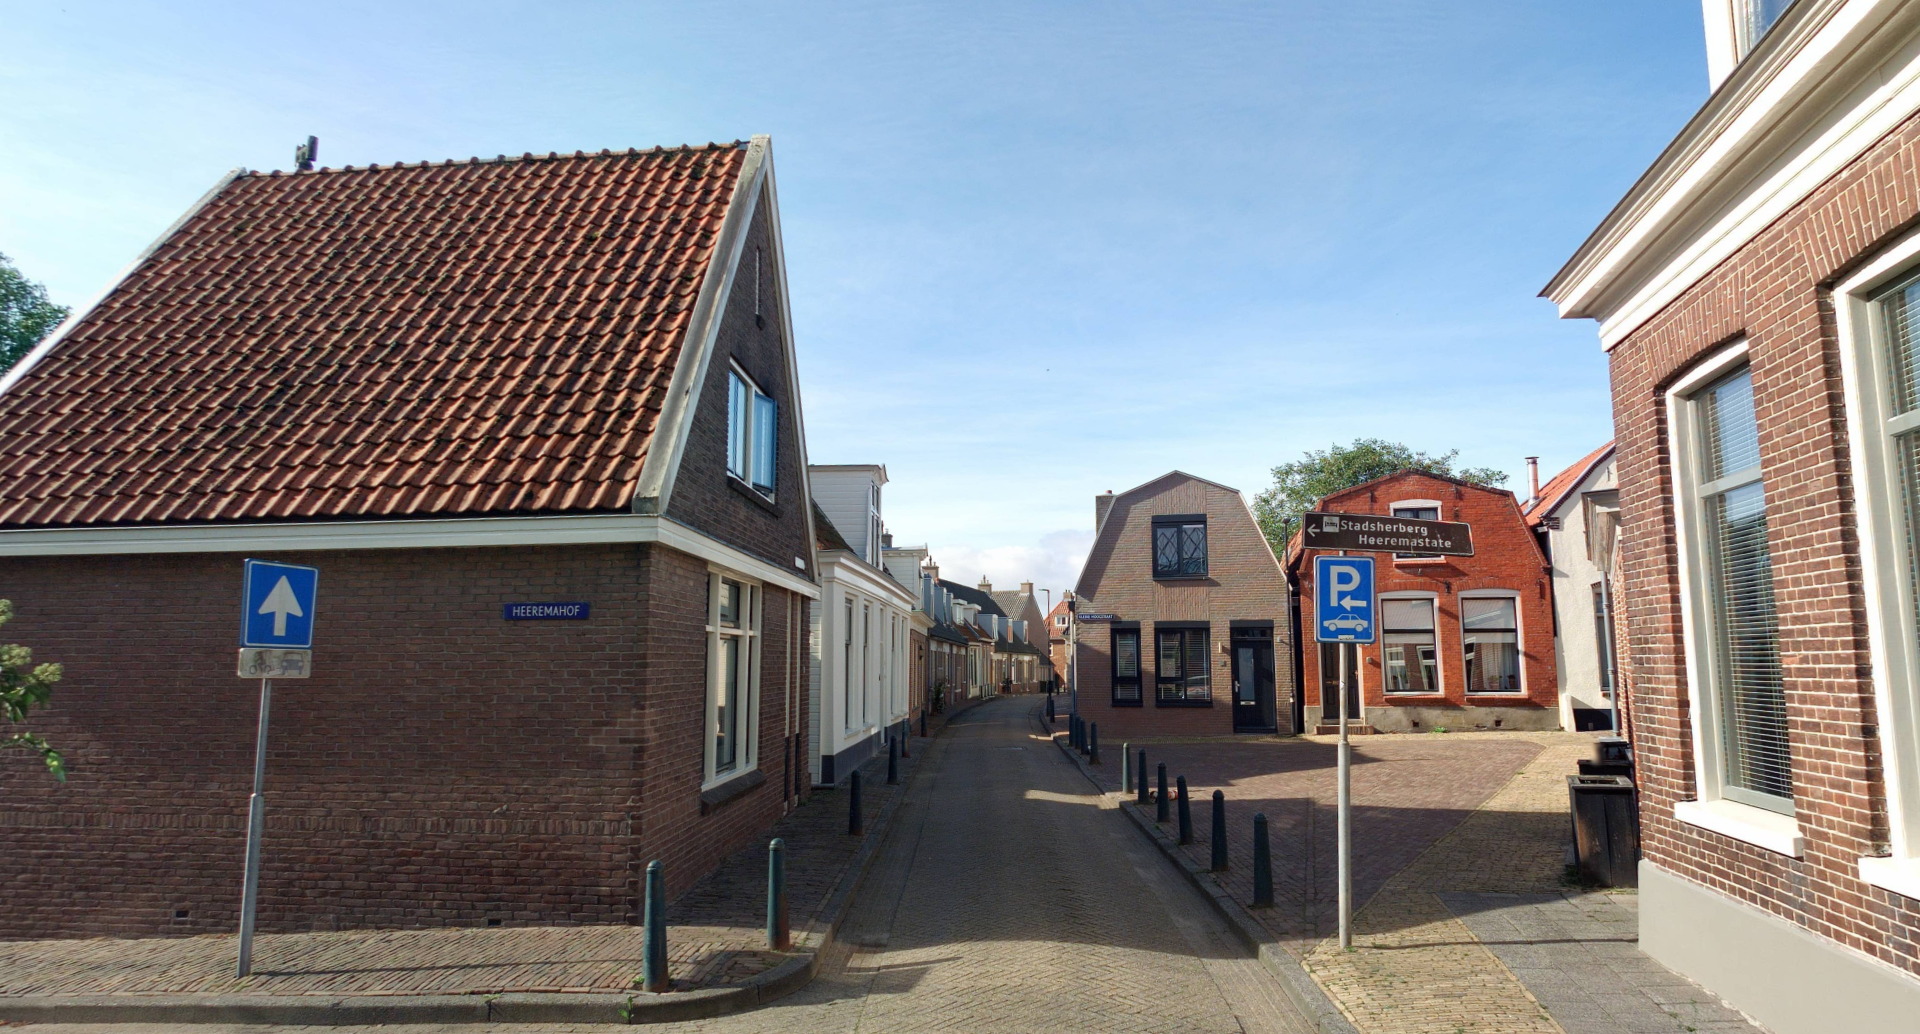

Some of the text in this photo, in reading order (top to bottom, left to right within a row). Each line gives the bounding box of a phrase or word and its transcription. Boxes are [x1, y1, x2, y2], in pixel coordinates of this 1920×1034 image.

[1340, 520, 1428, 536] Stadsherberg
[1358, 534, 1452, 548] Heeremastate
[1330, 565, 1361, 607] P
[512, 605, 580, 617] HEEREMAHOF
